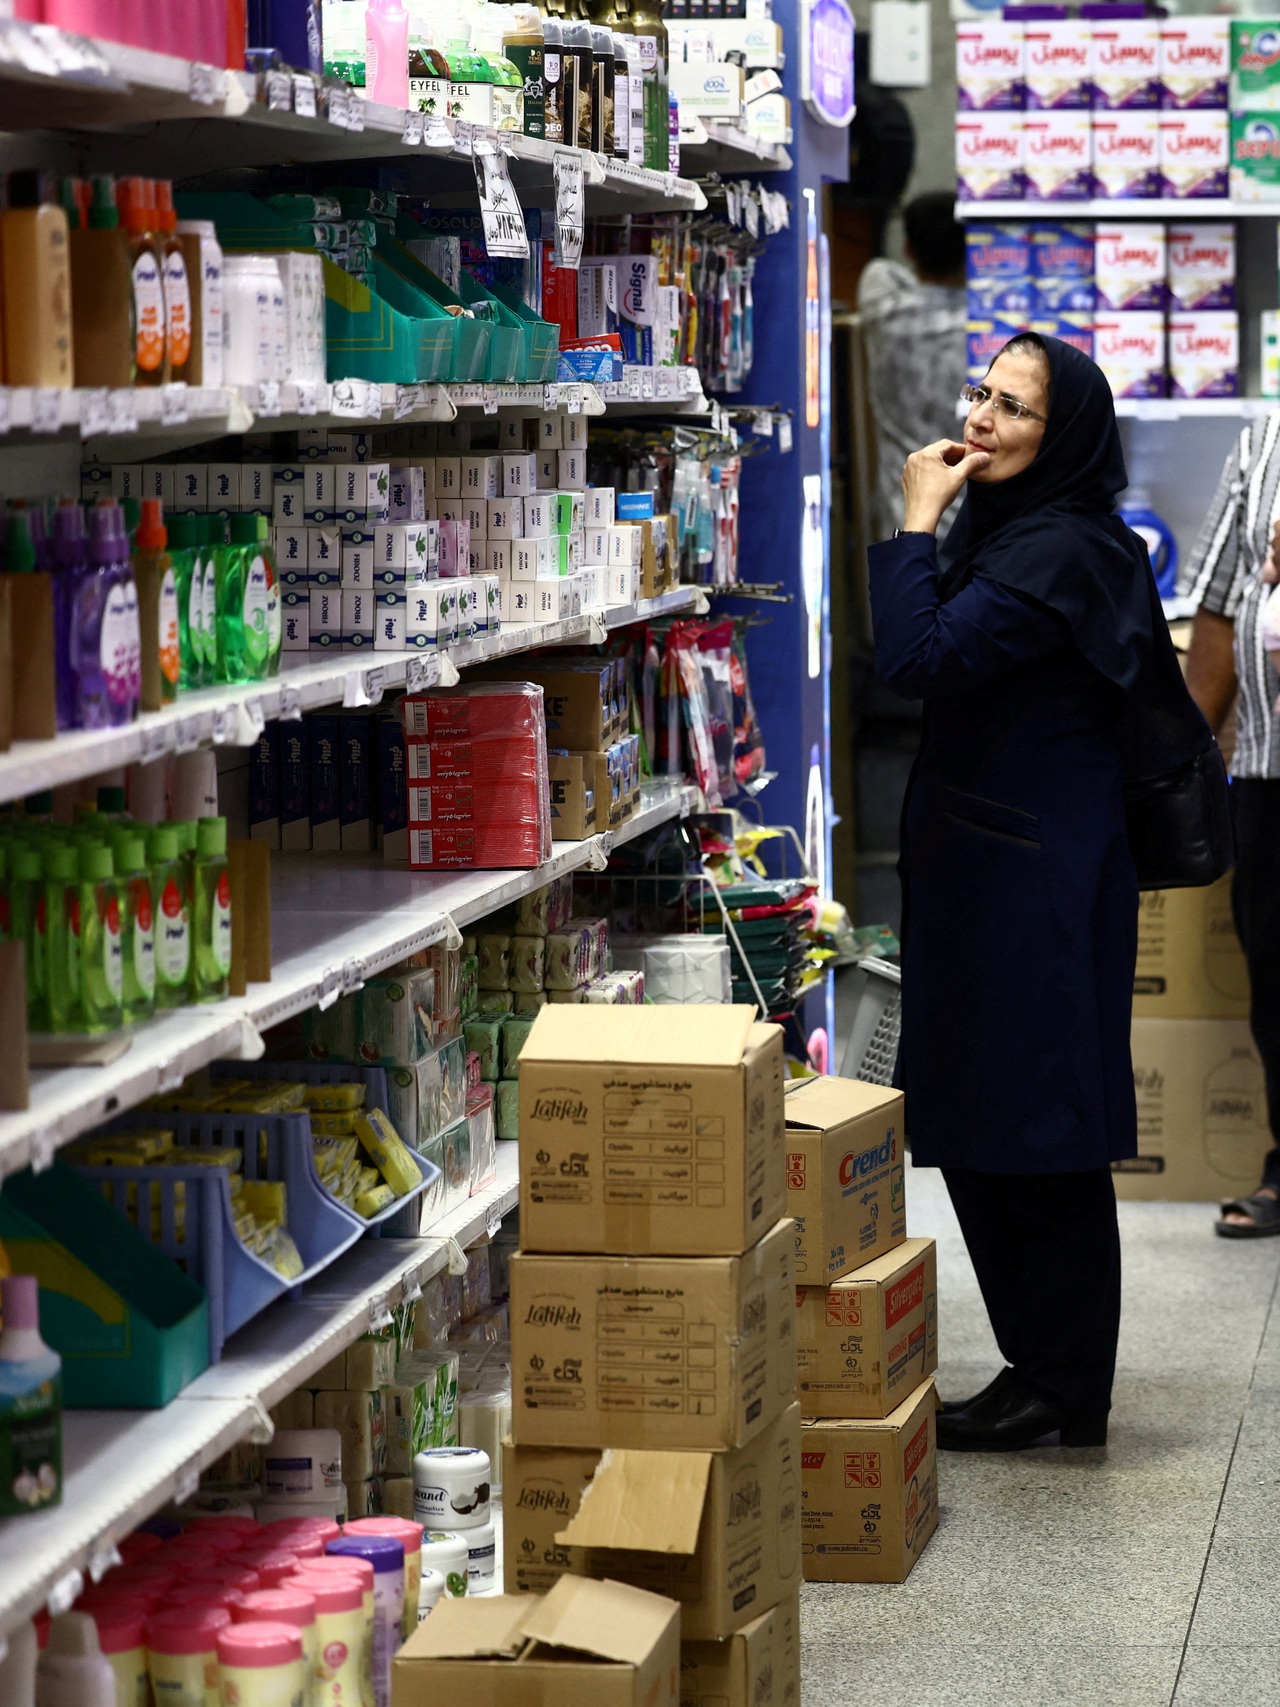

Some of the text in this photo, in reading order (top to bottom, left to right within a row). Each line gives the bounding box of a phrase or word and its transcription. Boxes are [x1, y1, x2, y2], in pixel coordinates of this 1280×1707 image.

[410, 80, 441, 92] EYFEL
[630, 262, 646, 313] Signal
[186, 474, 197, 496] فیروز
[218, 474, 229, 496] فیروز
[347, 472, 355, 500] FIROOZ
[393, 484, 406, 508] فیروز
[283, 495, 294, 517] فیروز
[286, 537, 298, 559] فیروز
[386, 532, 394, 561] FIROOZ
[321, 595, 329, 624] FIROOZ
[354, 595, 362, 624] FIROOZ
[416, 599, 428, 622] فیروز
[287, 618, 298, 640] فیروز
[384, 618, 397, 640] فیروز
[530, 1098, 589, 1122] Latifeh
[839, 1128, 894, 1188] Crend
[890, 1139, 896, 1162] 3
[889, 1272, 924, 1316] Silvergate
[524, 1303, 582, 1328] Latifeh
[516, 1487, 571, 1512] Latifeh
